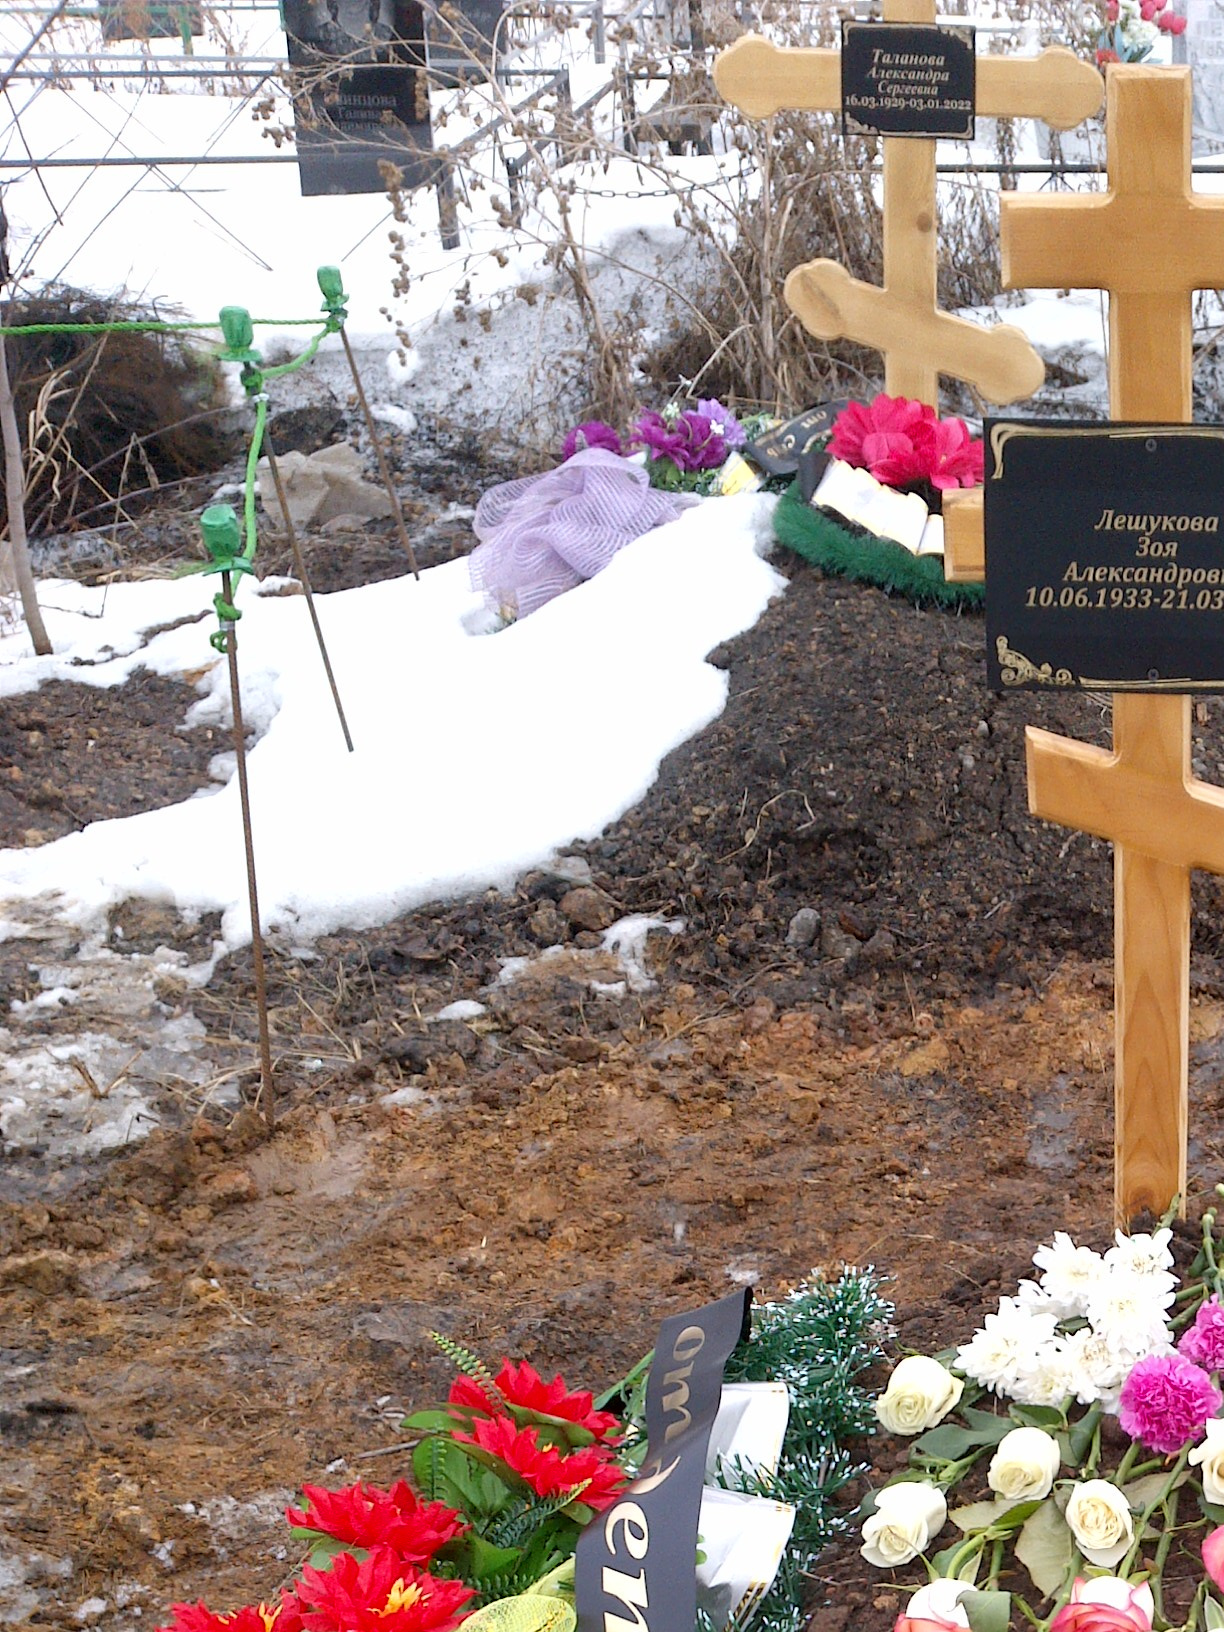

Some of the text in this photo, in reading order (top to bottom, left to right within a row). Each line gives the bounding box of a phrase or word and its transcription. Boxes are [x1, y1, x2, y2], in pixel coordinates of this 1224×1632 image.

[872, 48, 945, 66] Таланова
[867, 66, 949, 84] Александра
[877, 80, 938, 97] Сергеевна
[1094, 509, 1219, 536] Лешукова
[1135, 536, 1178, 558] Зоя
[662, 1325, 706, 1444] от
